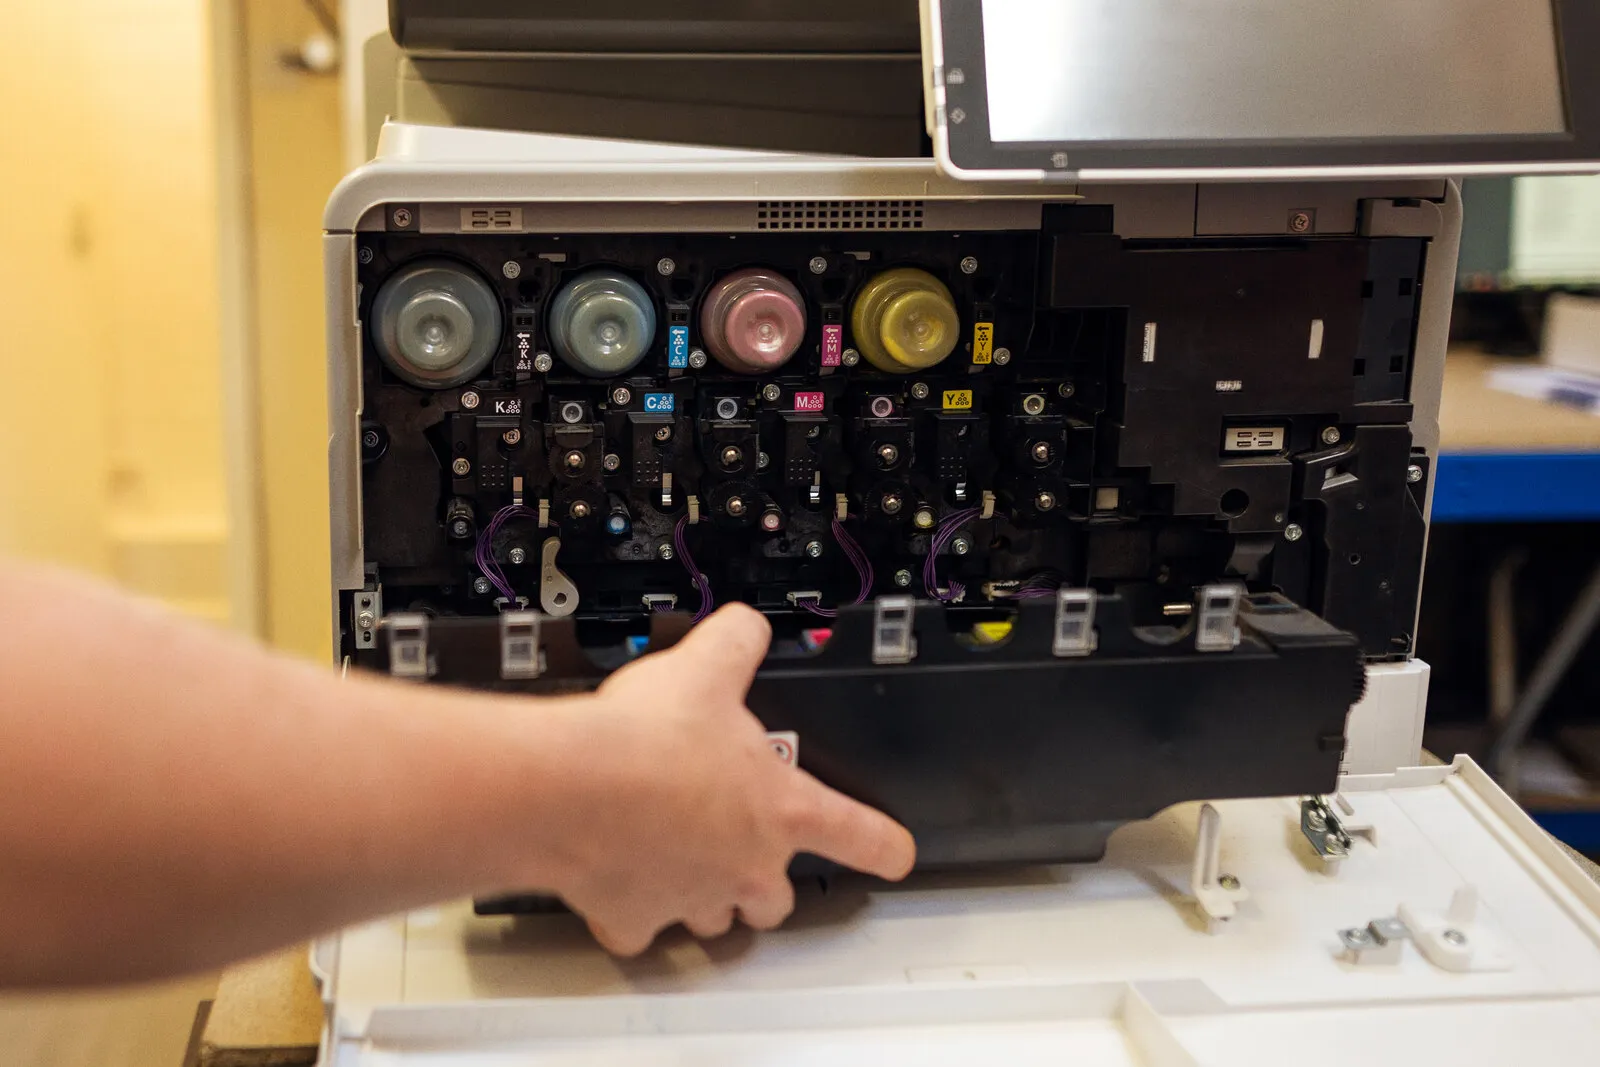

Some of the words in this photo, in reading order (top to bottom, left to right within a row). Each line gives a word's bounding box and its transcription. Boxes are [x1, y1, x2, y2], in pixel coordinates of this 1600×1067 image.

[675, 345, 682, 355] C
[827, 344, 836, 353] M
[980, 342, 987, 351] Y
[521, 349, 528, 359] K
[646, 397, 656, 409] C
[797, 396, 808, 408] M
[946, 394, 955, 405] Y
[495, 401, 505, 413] K
